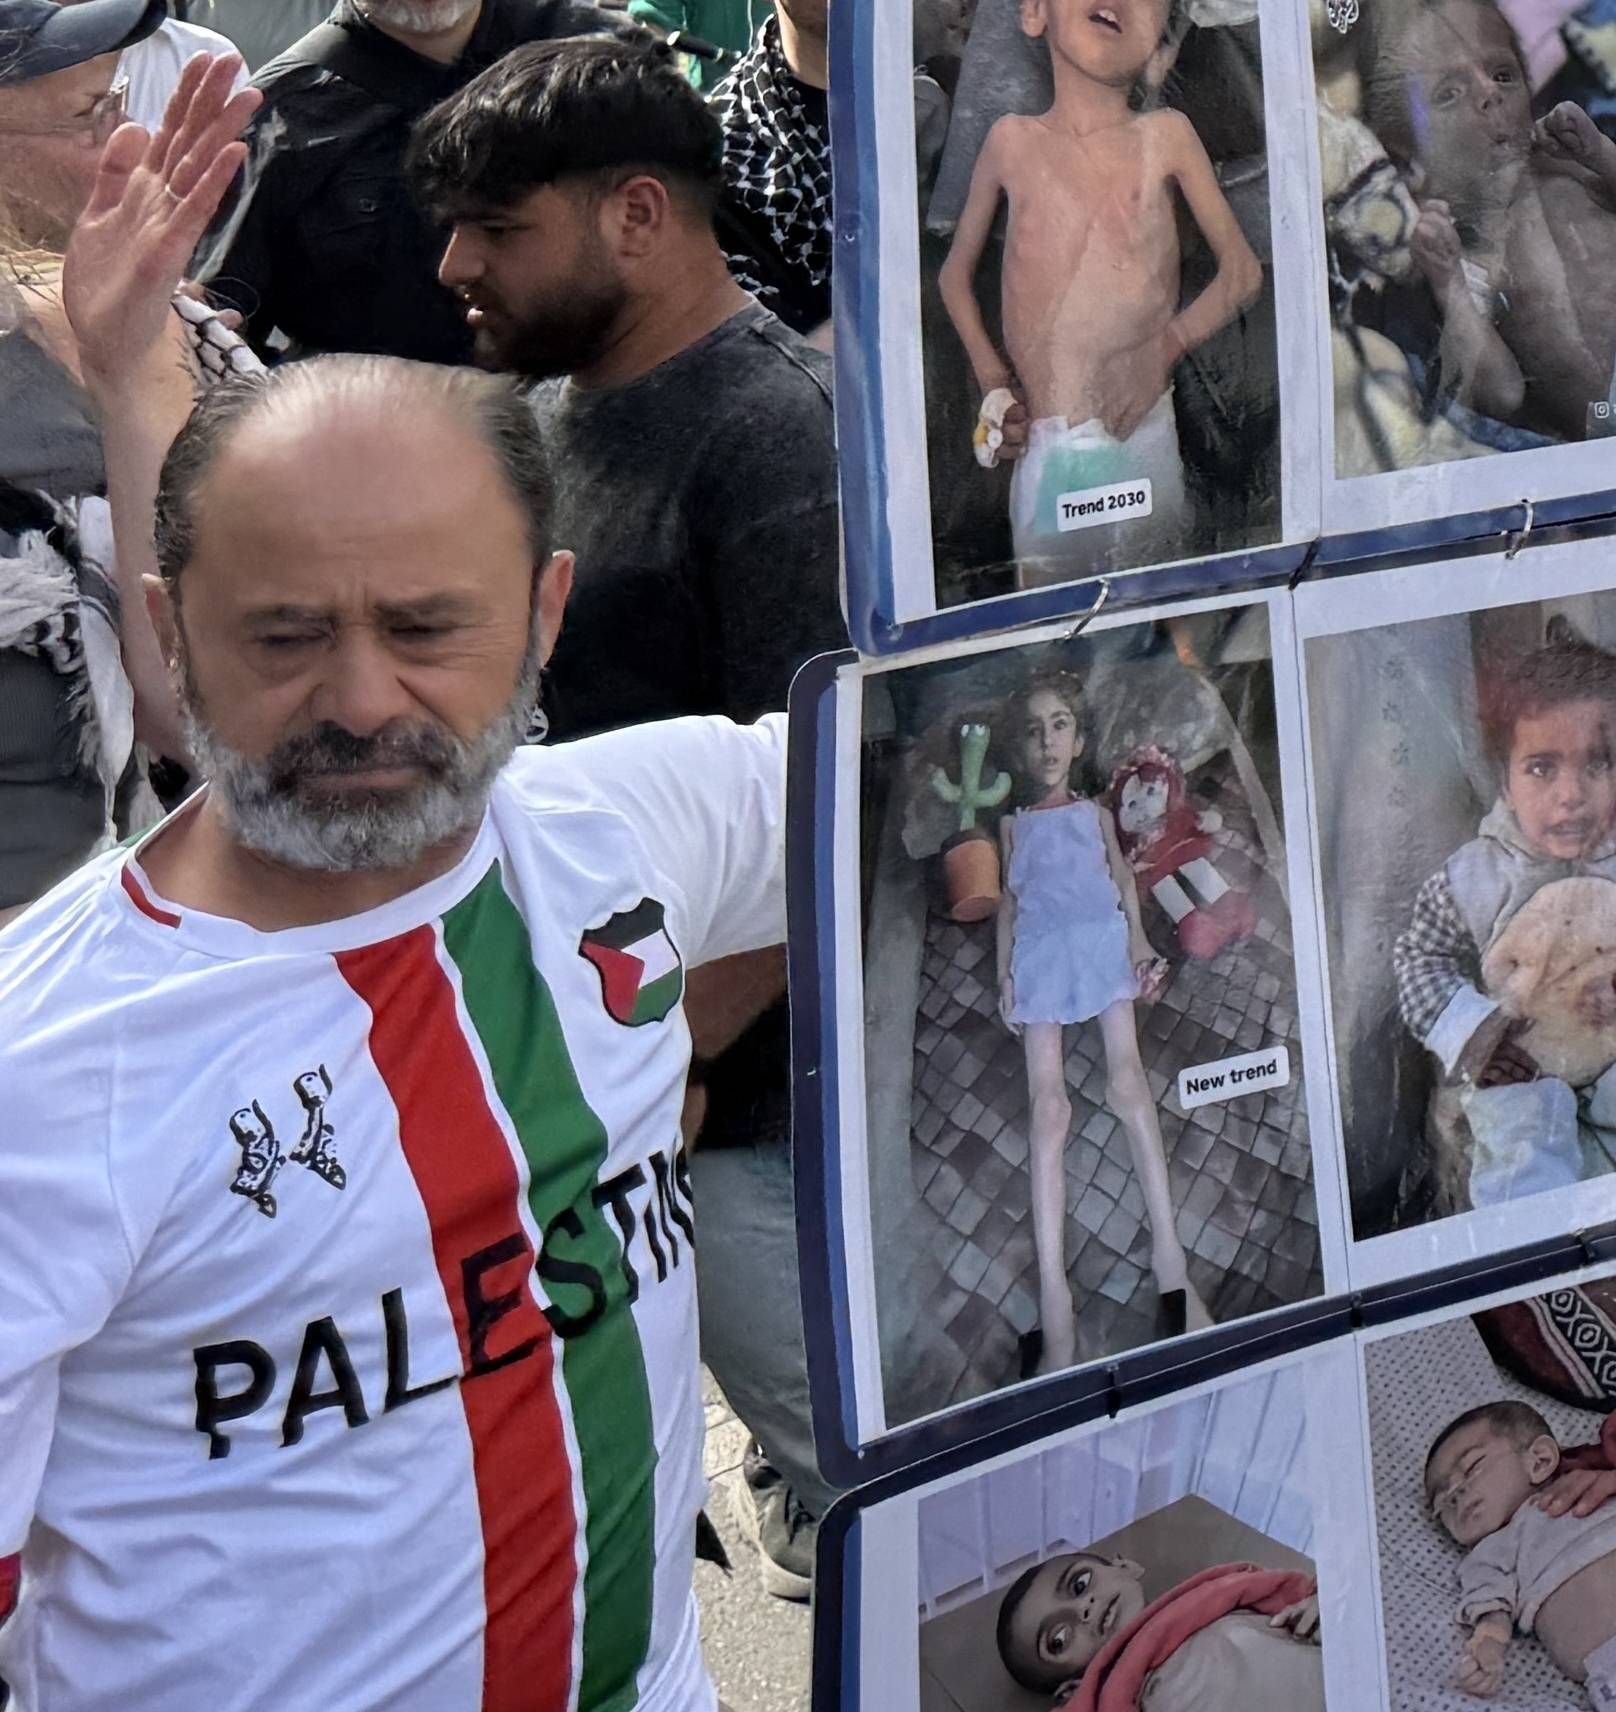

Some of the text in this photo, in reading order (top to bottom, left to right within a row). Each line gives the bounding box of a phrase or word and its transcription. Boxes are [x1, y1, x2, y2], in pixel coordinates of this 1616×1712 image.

[1061, 490, 1146, 519] Trend 2030
[1186, 1059, 1278, 1095] New trend
[193, 1146, 697, 1460] PALESTIN
